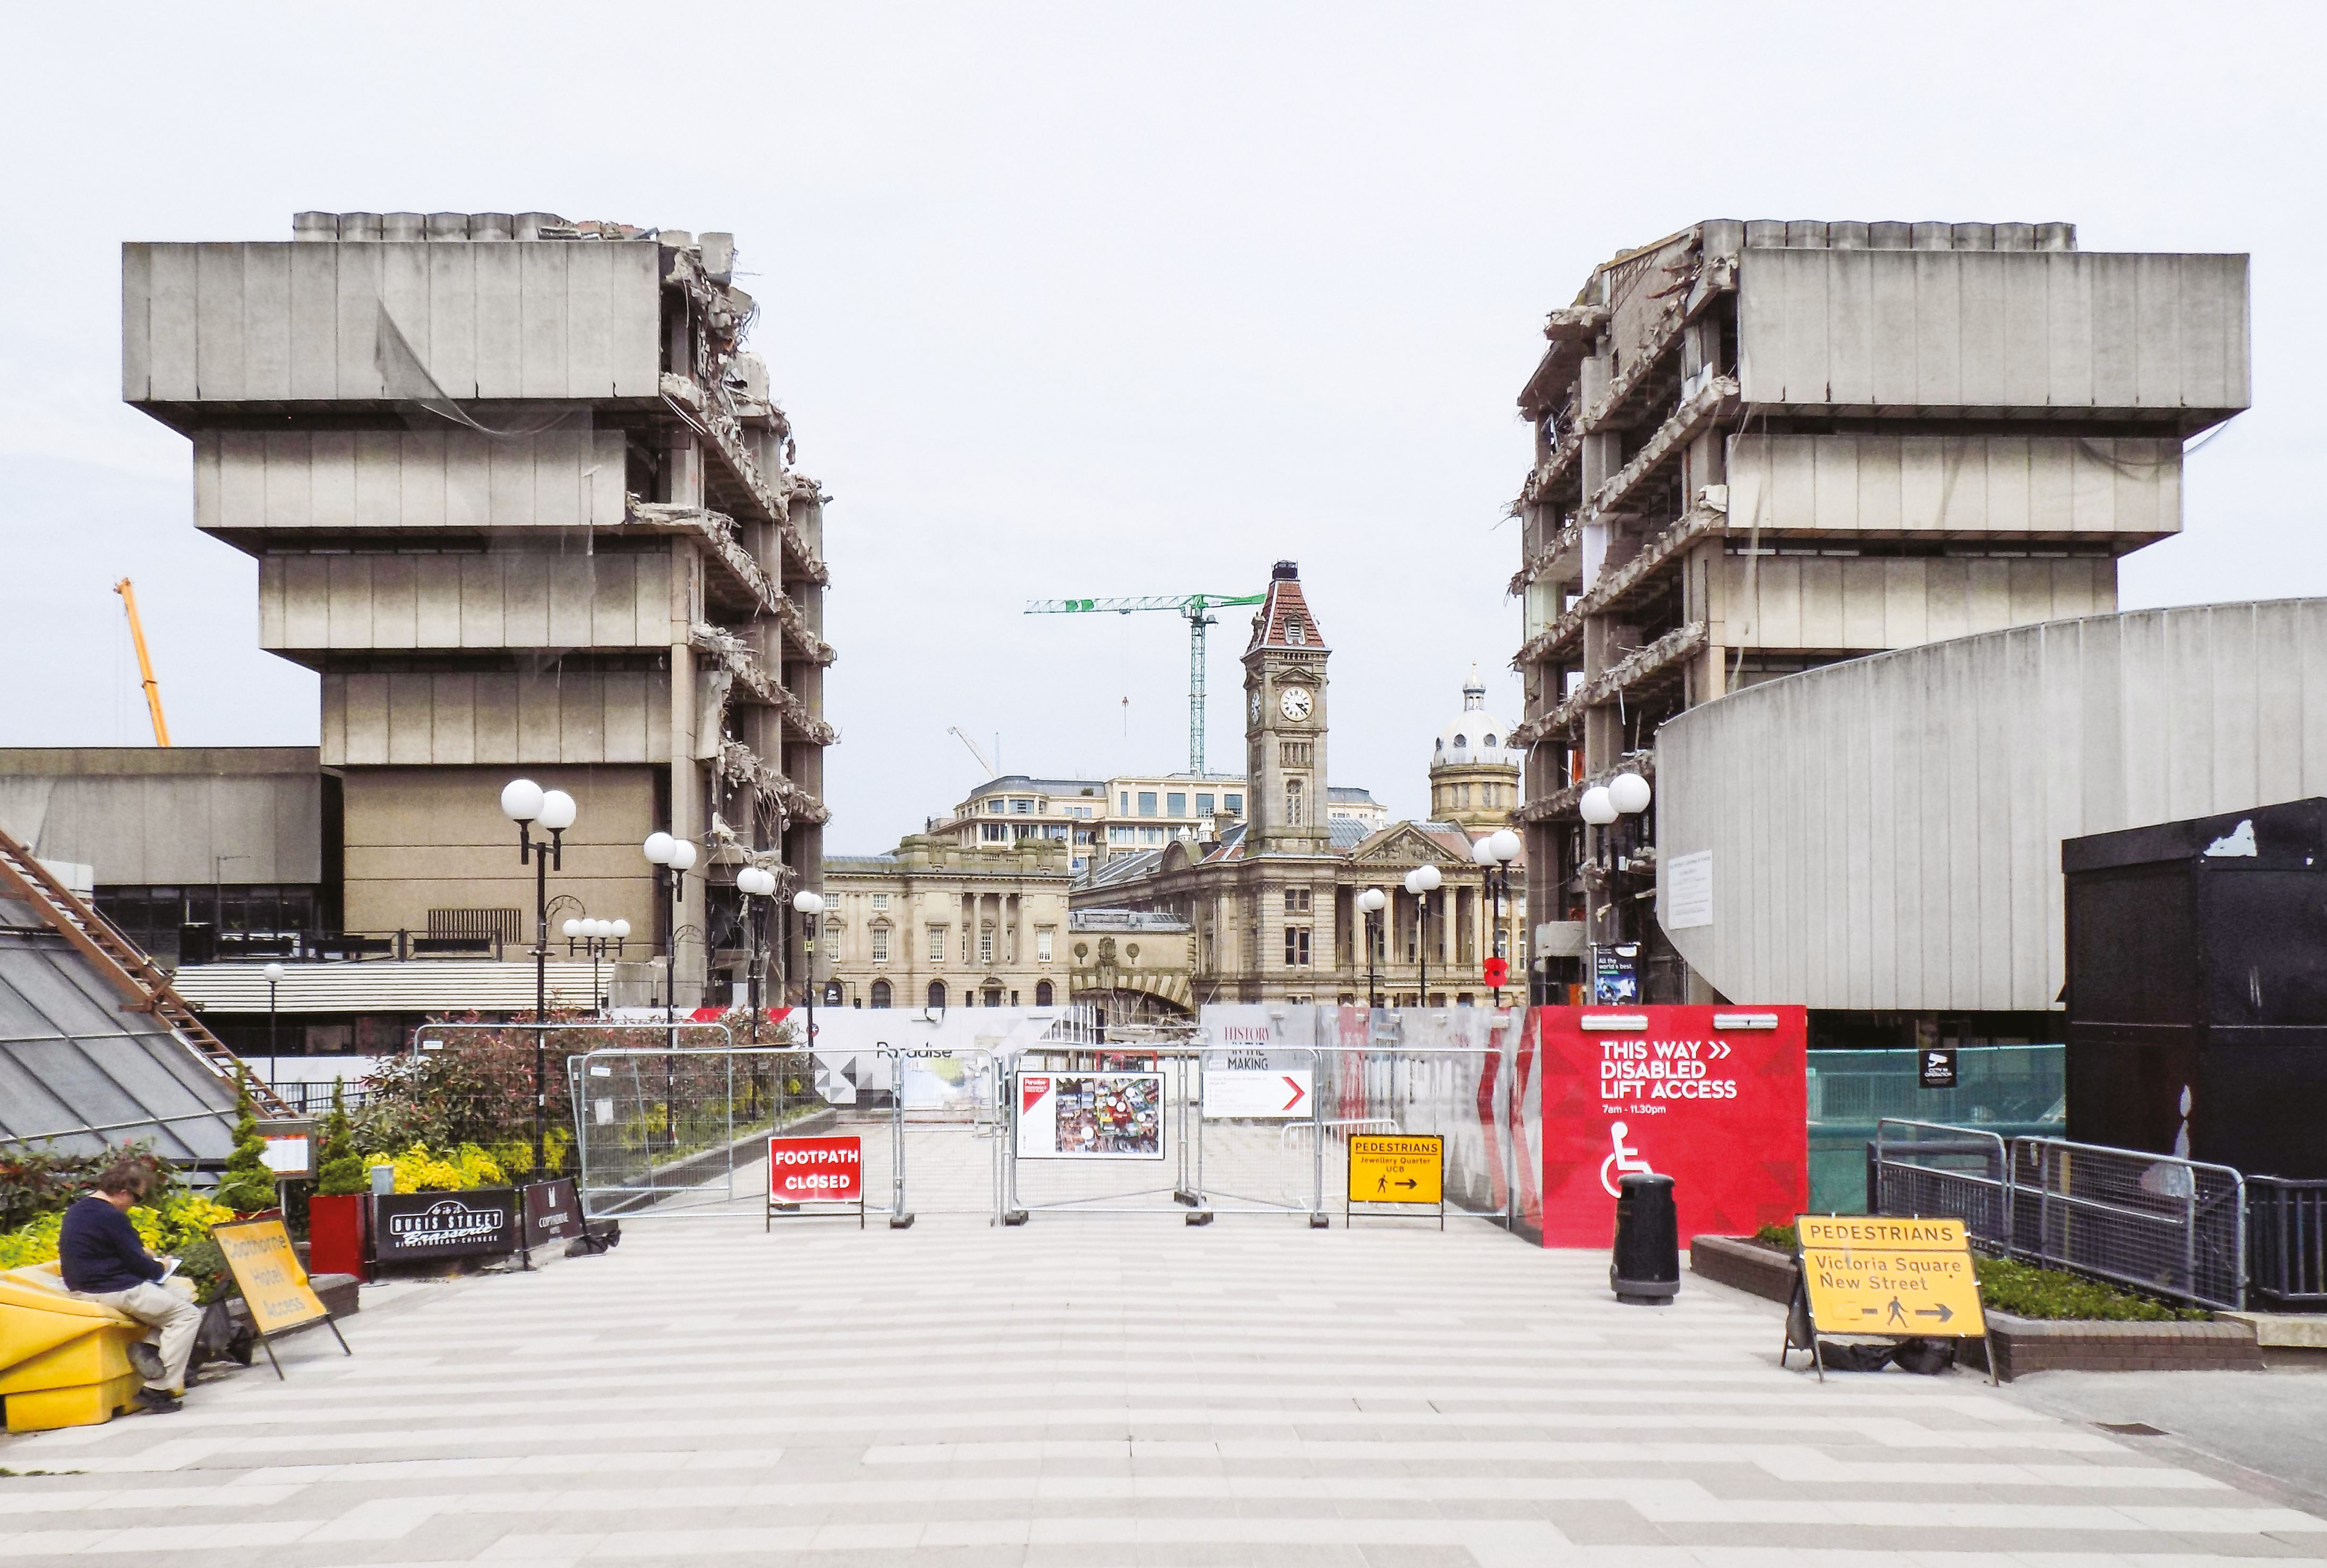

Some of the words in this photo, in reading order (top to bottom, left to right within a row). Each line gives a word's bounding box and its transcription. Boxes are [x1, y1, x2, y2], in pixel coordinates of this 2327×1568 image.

[1225, 1026, 1270, 1041] HISTORY
[1600, 1041, 1648, 1059] THIS
[1653, 1041, 1701, 1059] WAY
[1228, 1057, 1268, 1070] MAKING
[1601, 1061, 1707, 1079] DISABLED
[1601, 1080, 1646, 1099] LIFT
[1651, 1080, 1737, 1099] ACCESS
[1602, 1104, 1622, 1113] 7am
[1630, 1104, 1666, 1115] 11.30pm
[1355, 1143, 1438, 1152] PEDESTRIANS
[775, 1149, 859, 1165] FOOTPATH
[785, 1174, 850, 1190] CLOSED
[395, 1216, 439, 1232] BUGIS
[448, 1213, 499, 1229] STREET
[403, 1224, 493, 1245] Brasserie
[1810, 1225, 1953, 1241] PEDESTRIANS
[1815, 1255, 1887, 1271] Victoria
[1895, 1257, 1961, 1274] Square
[250, 1263, 285, 1286] Hotel
[1819, 1272, 1860, 1289] New
[1869, 1276, 1928, 1291] Street
